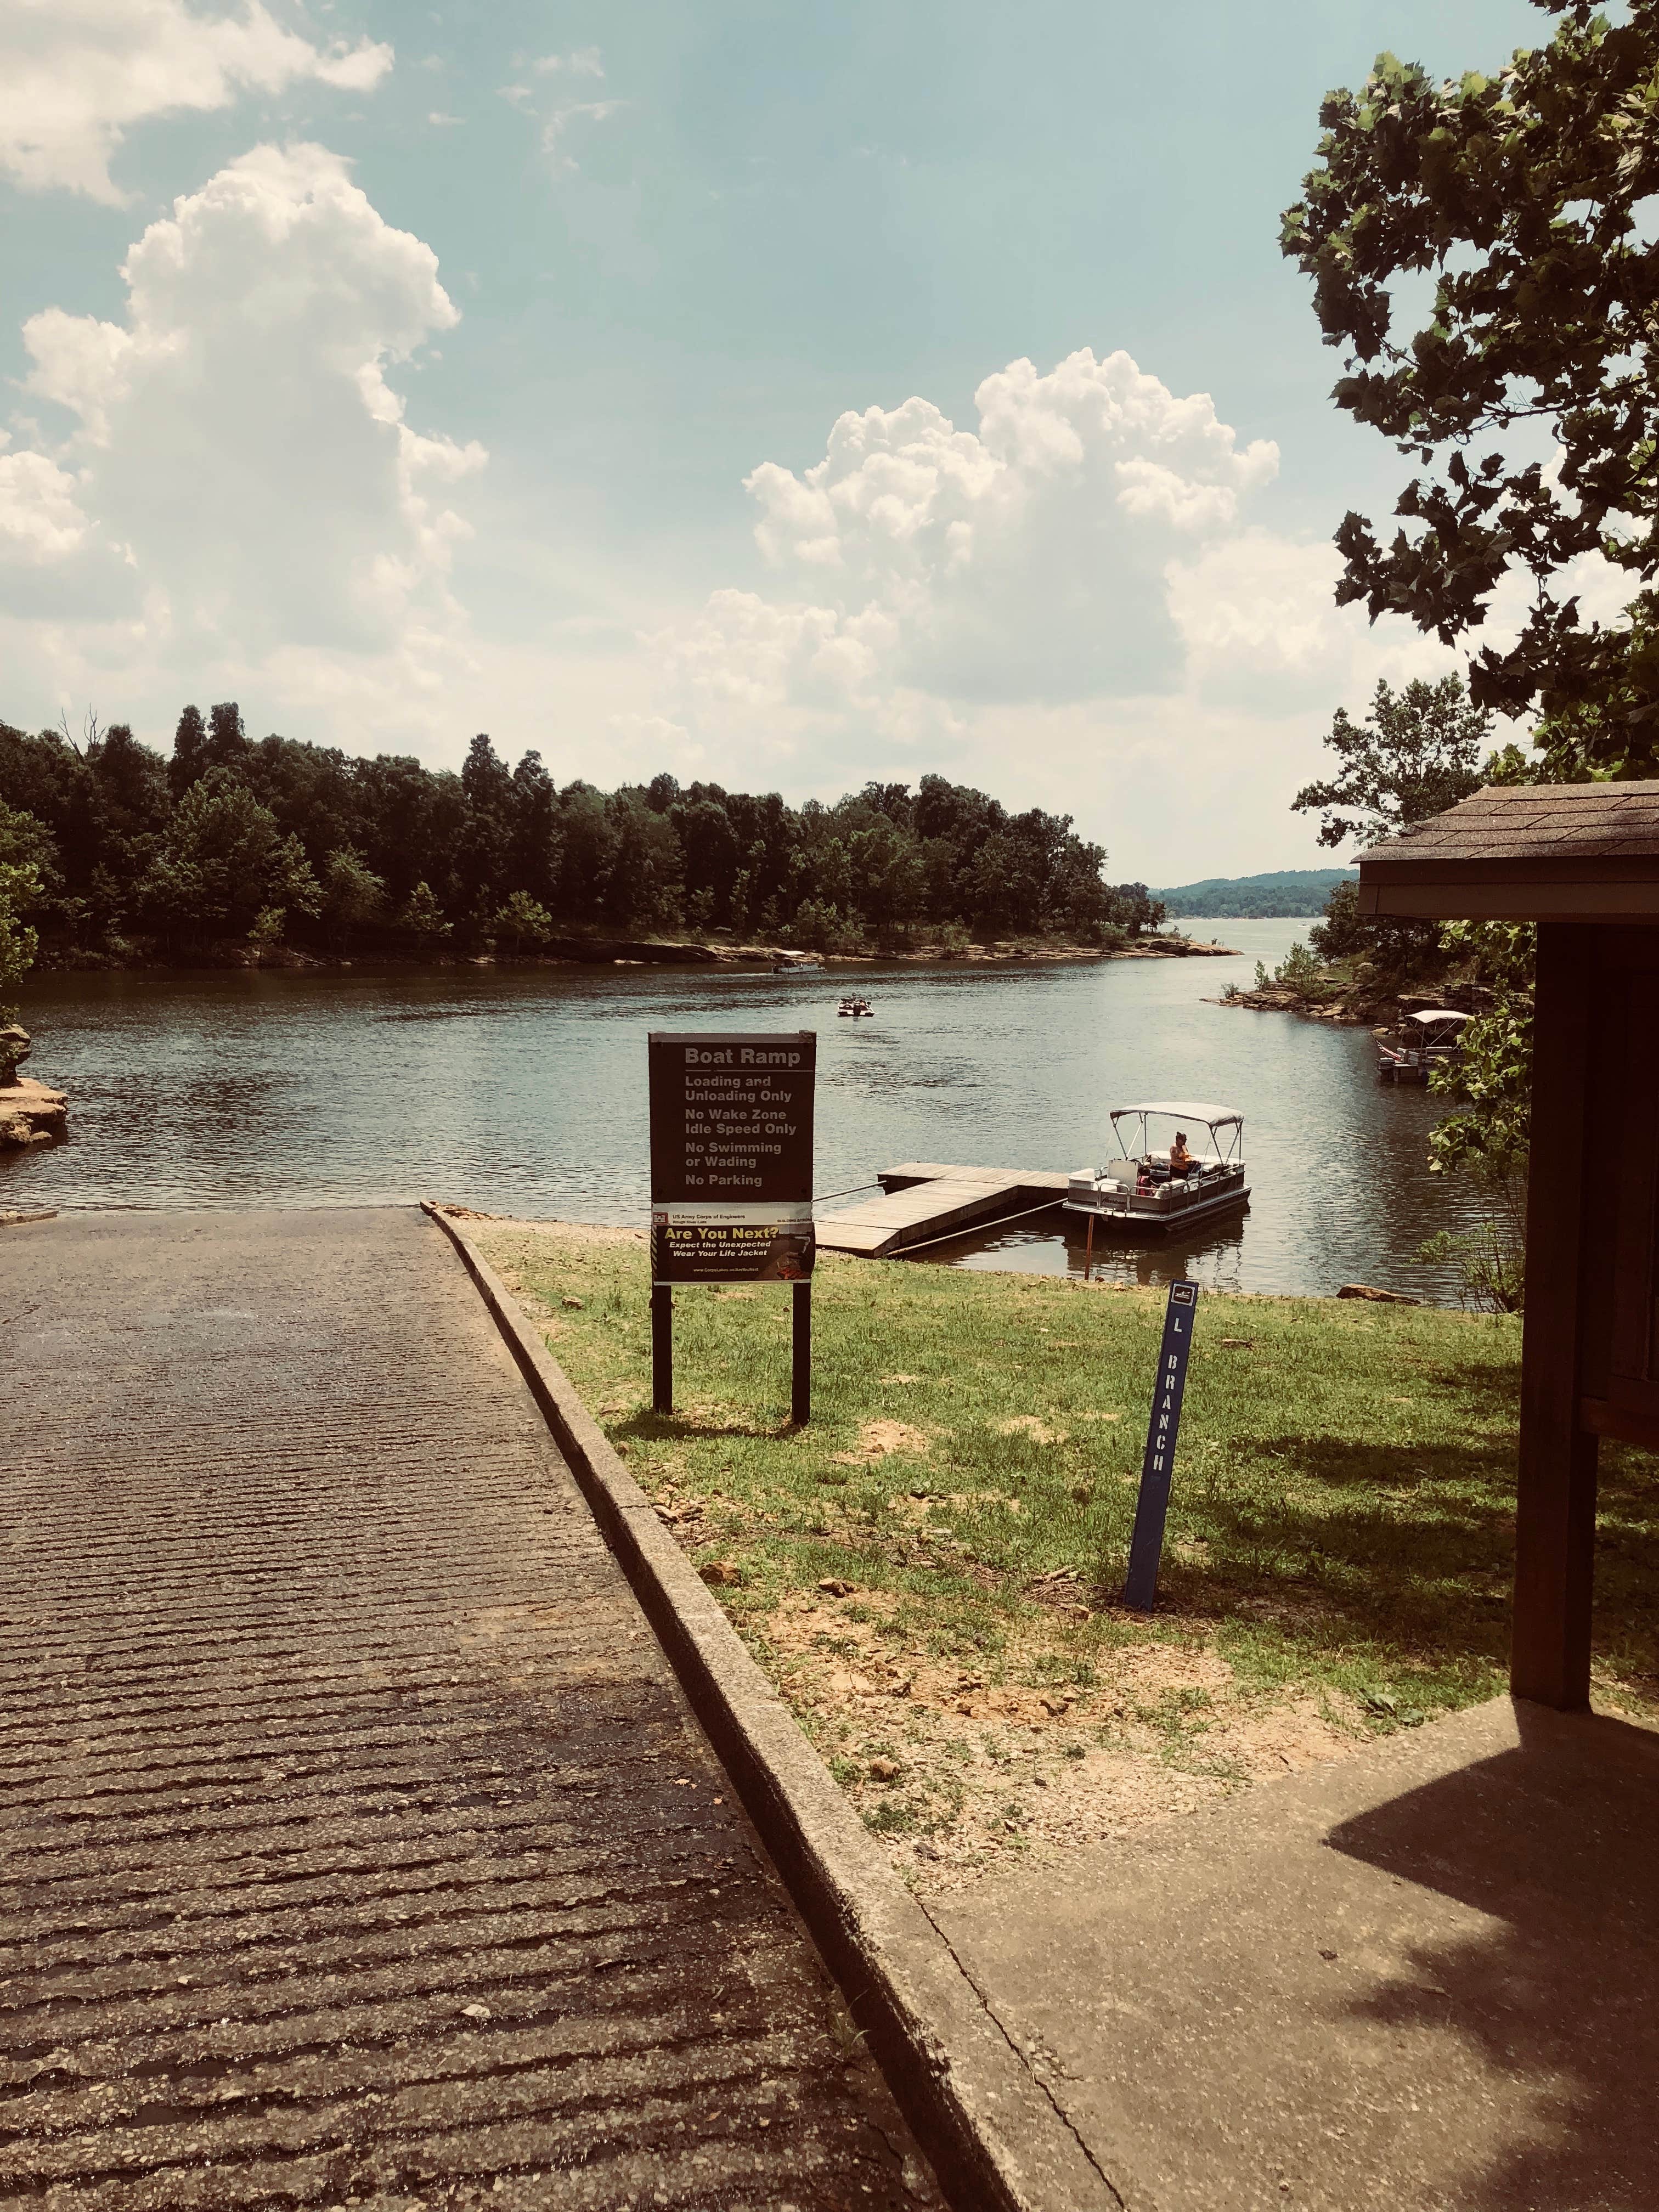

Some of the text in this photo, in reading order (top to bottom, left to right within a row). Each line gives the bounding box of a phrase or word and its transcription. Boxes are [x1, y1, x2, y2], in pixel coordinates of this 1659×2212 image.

[685, 1048, 800, 1066] Boat Ramp
[685, 1076, 771, 1088] Loading and
[685, 1090, 792, 1103] Unloading Only
[685, 1109, 787, 1120] No Wake Zone
[685, 1123, 797, 1136] Idle Speed Only
[685, 1142, 782, 1154] No Swimming
[685, 1156, 757, 1169] or Wading
[685, 1175, 762, 1187] No Parking
[664, 1227, 780, 1239] Are You Next?
[1153, 1318, 1182, 1471] L BRANCH
